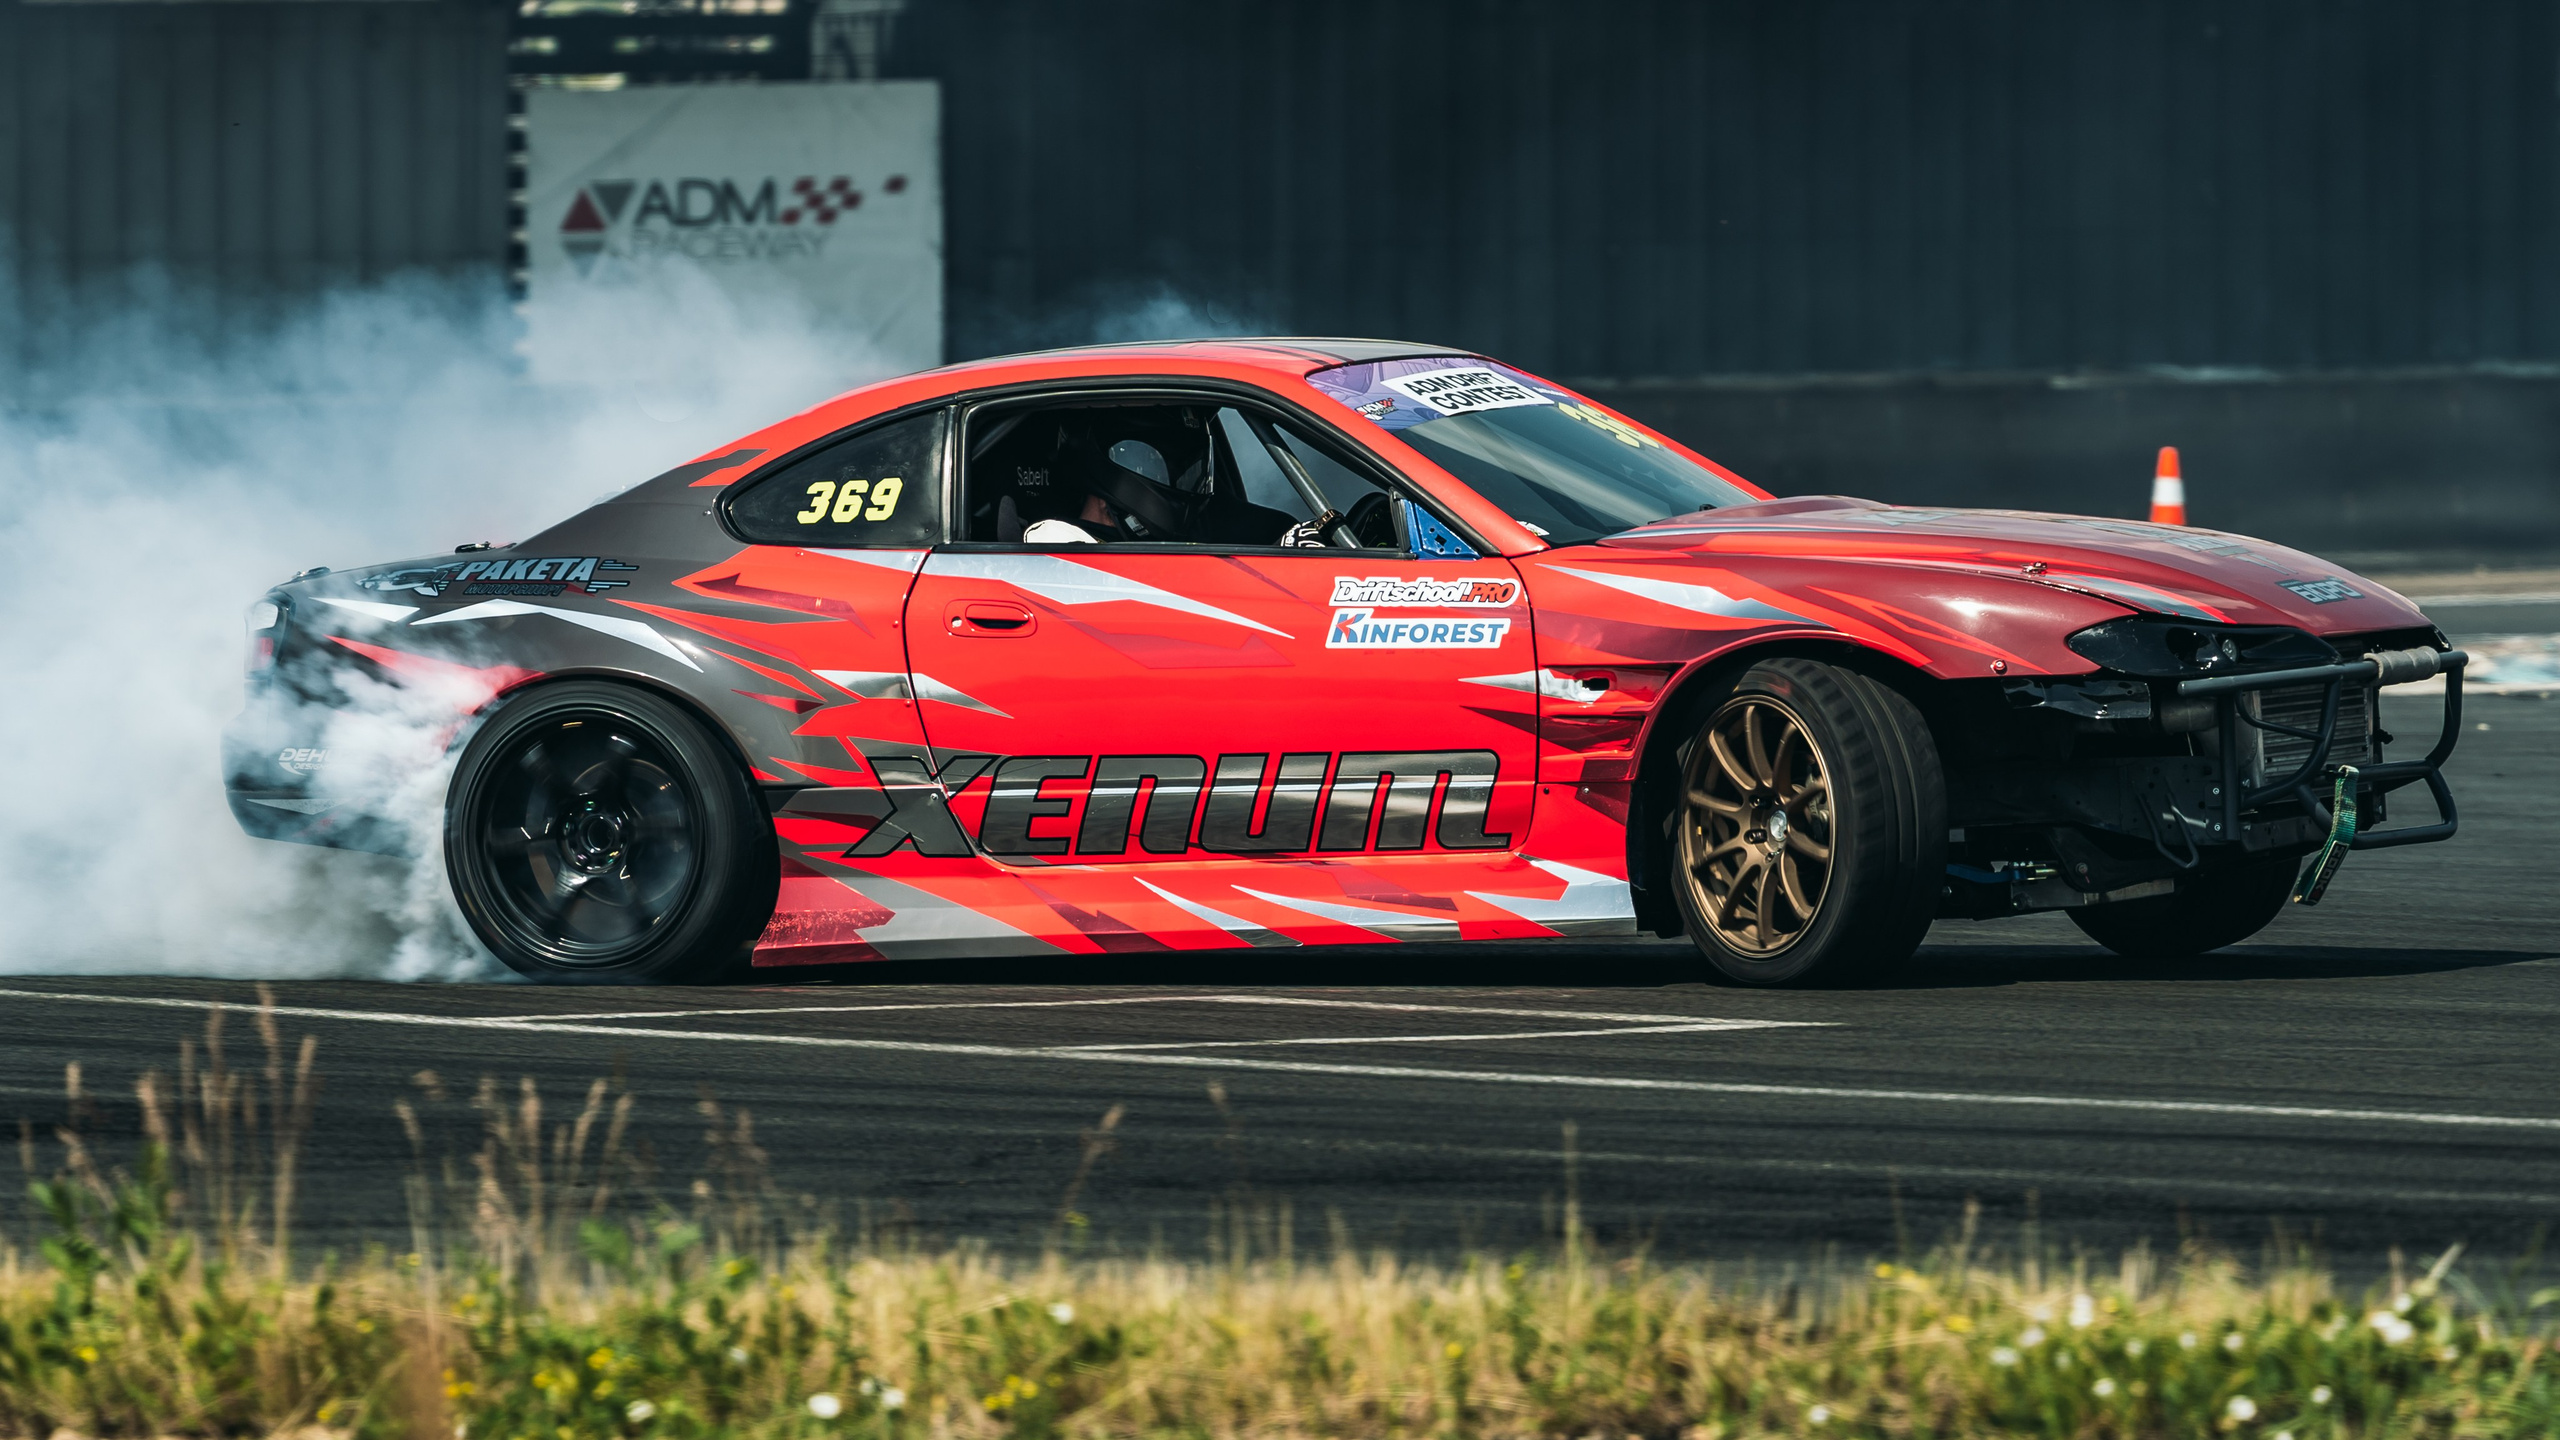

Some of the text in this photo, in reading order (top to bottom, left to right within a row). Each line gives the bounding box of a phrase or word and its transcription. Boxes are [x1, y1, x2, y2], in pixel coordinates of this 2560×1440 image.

[634, 177, 778, 226] ADM
[1404, 372, 1506, 396] ADM DRIFT
[1429, 385, 1535, 410] CONTEST
[1016, 465, 1050, 486] Sabelt
[796, 477, 904, 524] 369
[1331, 613, 1504, 643] KINFOREST
